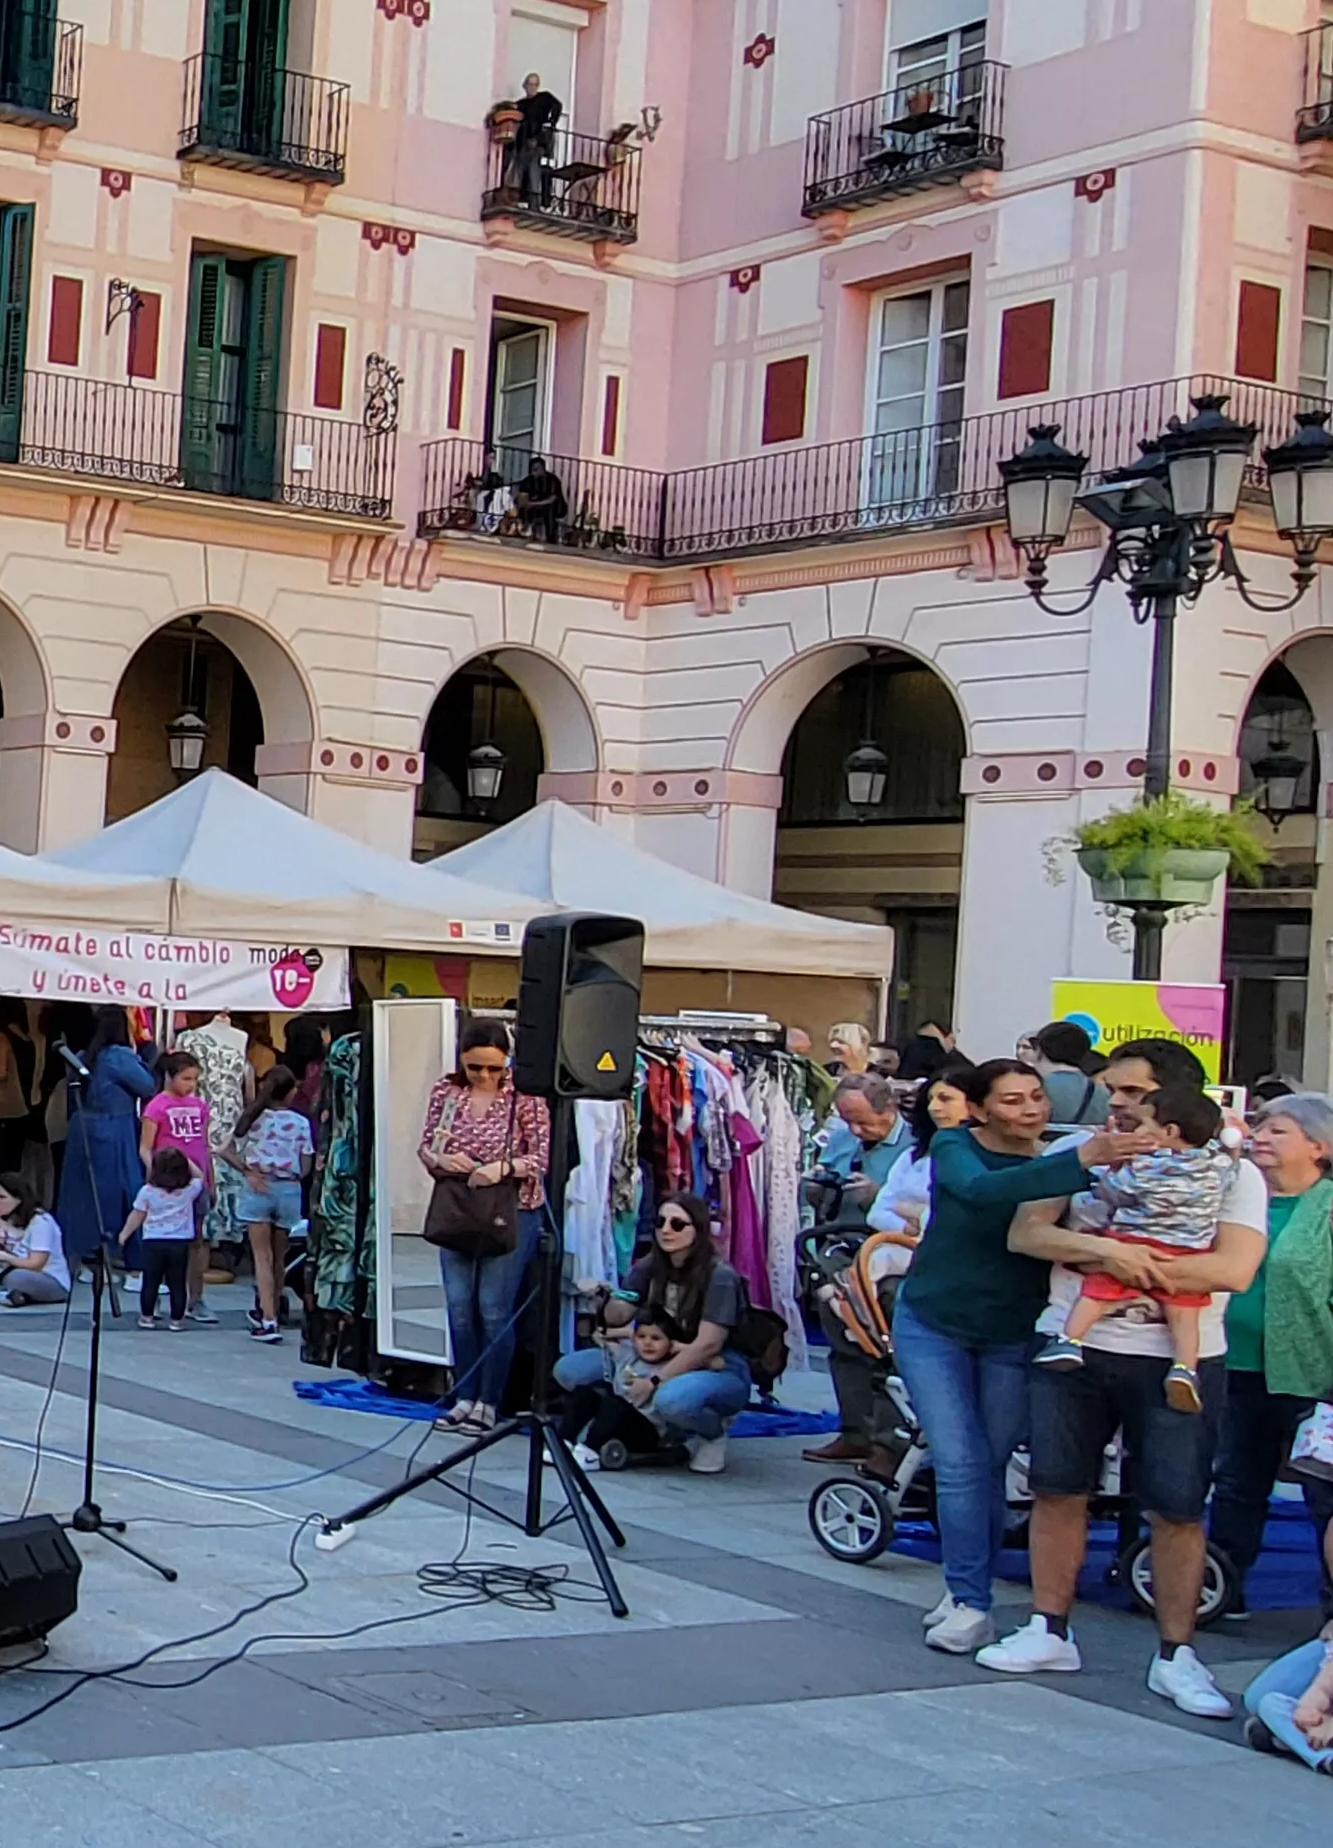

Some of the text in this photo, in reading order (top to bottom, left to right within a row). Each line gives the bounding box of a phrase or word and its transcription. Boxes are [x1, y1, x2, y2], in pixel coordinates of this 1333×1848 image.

[109, 935, 133, 959] al
[32, 969, 46, 993] y
[137, 981, 153, 999] a
[165, 978, 188, 1001] la
